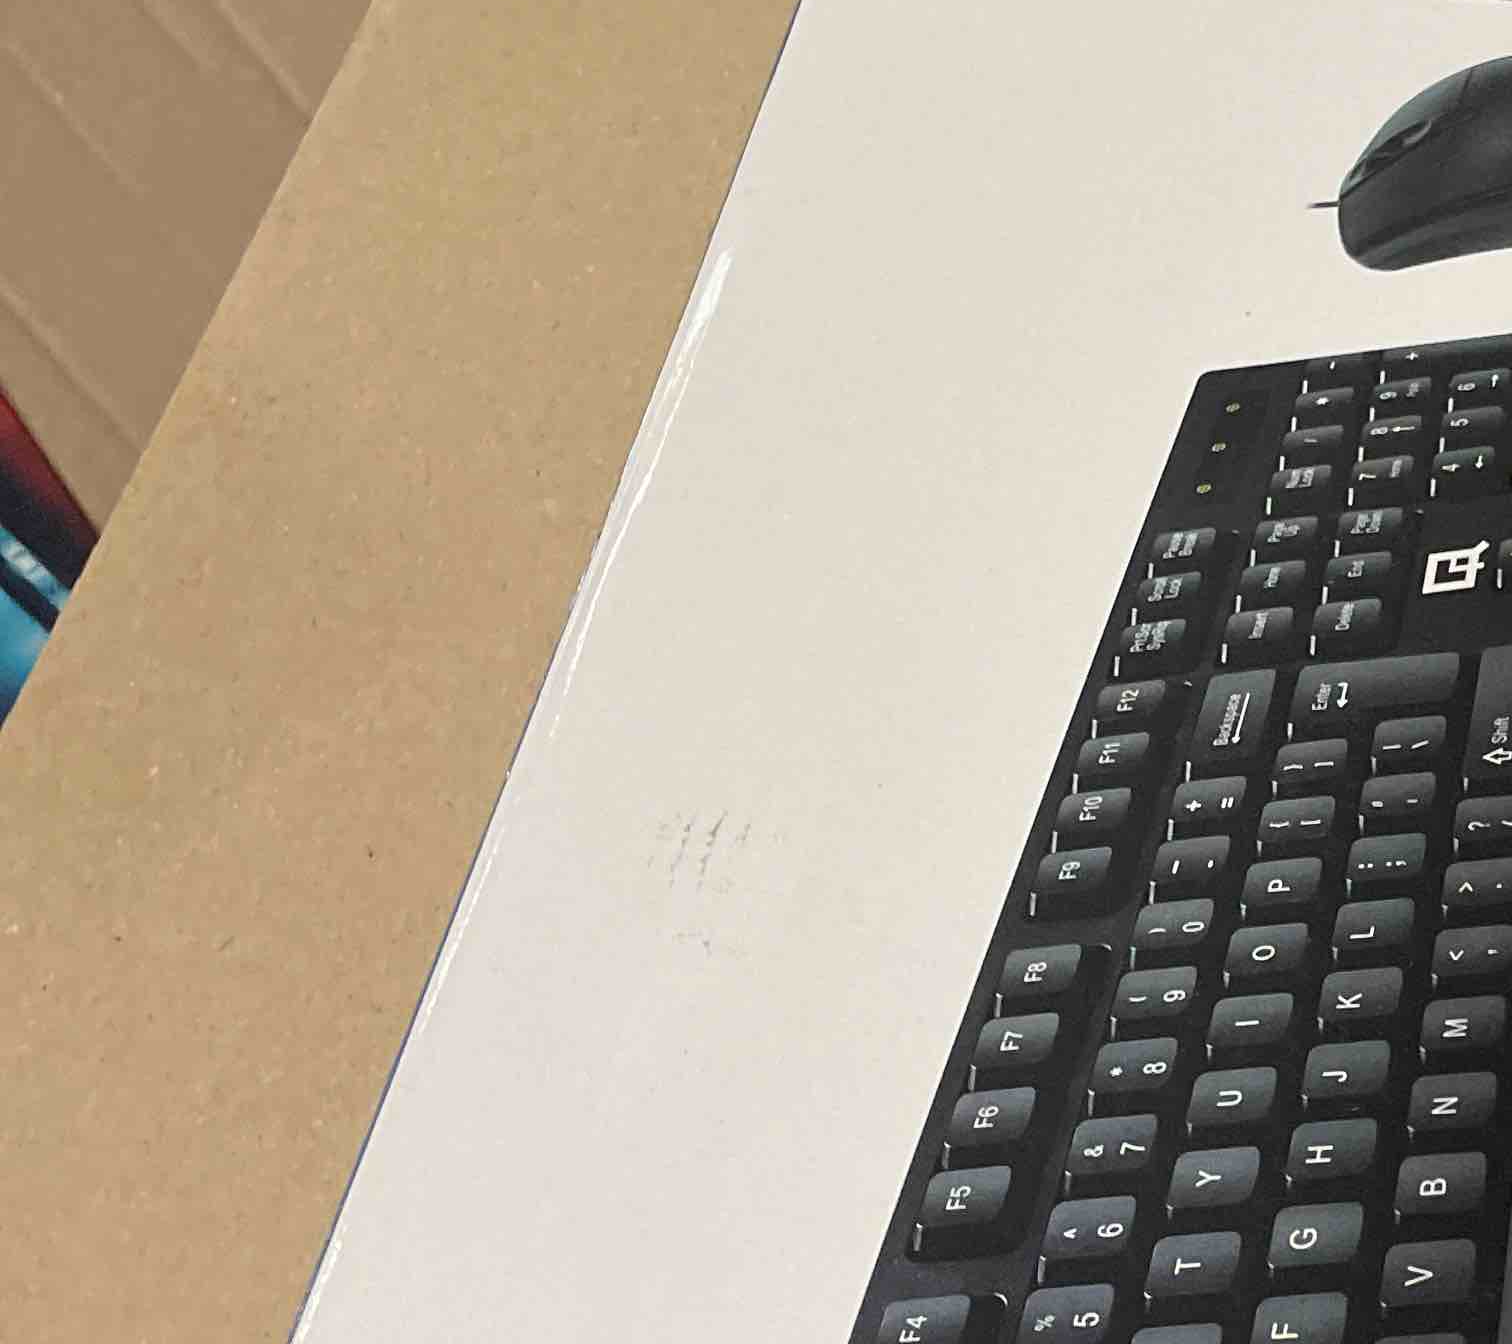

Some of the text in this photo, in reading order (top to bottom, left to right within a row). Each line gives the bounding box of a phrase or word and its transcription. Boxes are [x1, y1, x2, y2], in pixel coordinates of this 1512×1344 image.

[1379, 391, 1398, 401] 9
[1456, 382, 1476, 392] 6
[1369, 426, 1389, 436] 8
[1449, 417, 1469, 427] 5
[1358, 472, 1377, 481] 7
[1441, 463, 1461, 472] 4
[1116, 687, 1140, 713] F12
[1311, 682, 1332, 711] Enter
[1490, 715, 1511, 746] Shift
[1098, 742, 1121, 765] F11
[1078, 795, 1104, 822] F10
[1057, 860, 1081, 881] F9
[1266, 878, 1291, 894] P
[1181, 920, 1205, 934] 0
[1349, 925, 1376, 940] L
[1251, 944, 1276, 962] O
[1023, 960, 1048, 984] F8
[1162, 988, 1187, 1003] 9
[1335, 992, 1364, 1010] K
[1233, 1019, 1260, 1027] I
[1442, 1017, 1470, 1038] M
[999, 1030, 1025, 1053] F7
[1142, 1060, 1168, 1076] 8
[1321, 1070, 1349, 1084] J
[1215, 1089, 1243, 1108] U
[1430, 1096, 1459, 1116] N
[973, 1104, 999, 1129] F6
[1083, 1143, 1106, 1158] &
[1118, 1141, 1147, 1157] 7
[1304, 1143, 1335, 1165] H
[1195, 1168, 1223, 1189] Y
[1418, 1177, 1447, 1197] B
[944, 1184, 972, 1211] F5
[1097, 1222, 1125, 1239] 6
[1288, 1227, 1319, 1251] G
[1173, 1258, 1202, 1277] T
[1403, 1264, 1435, 1288] V
[899, 1314, 929, 1344] F4
[1033, 1313, 1057, 1334] %
[1072, 1311, 1101, 1329] 5
[1270, 1321, 1300, 1341] F
